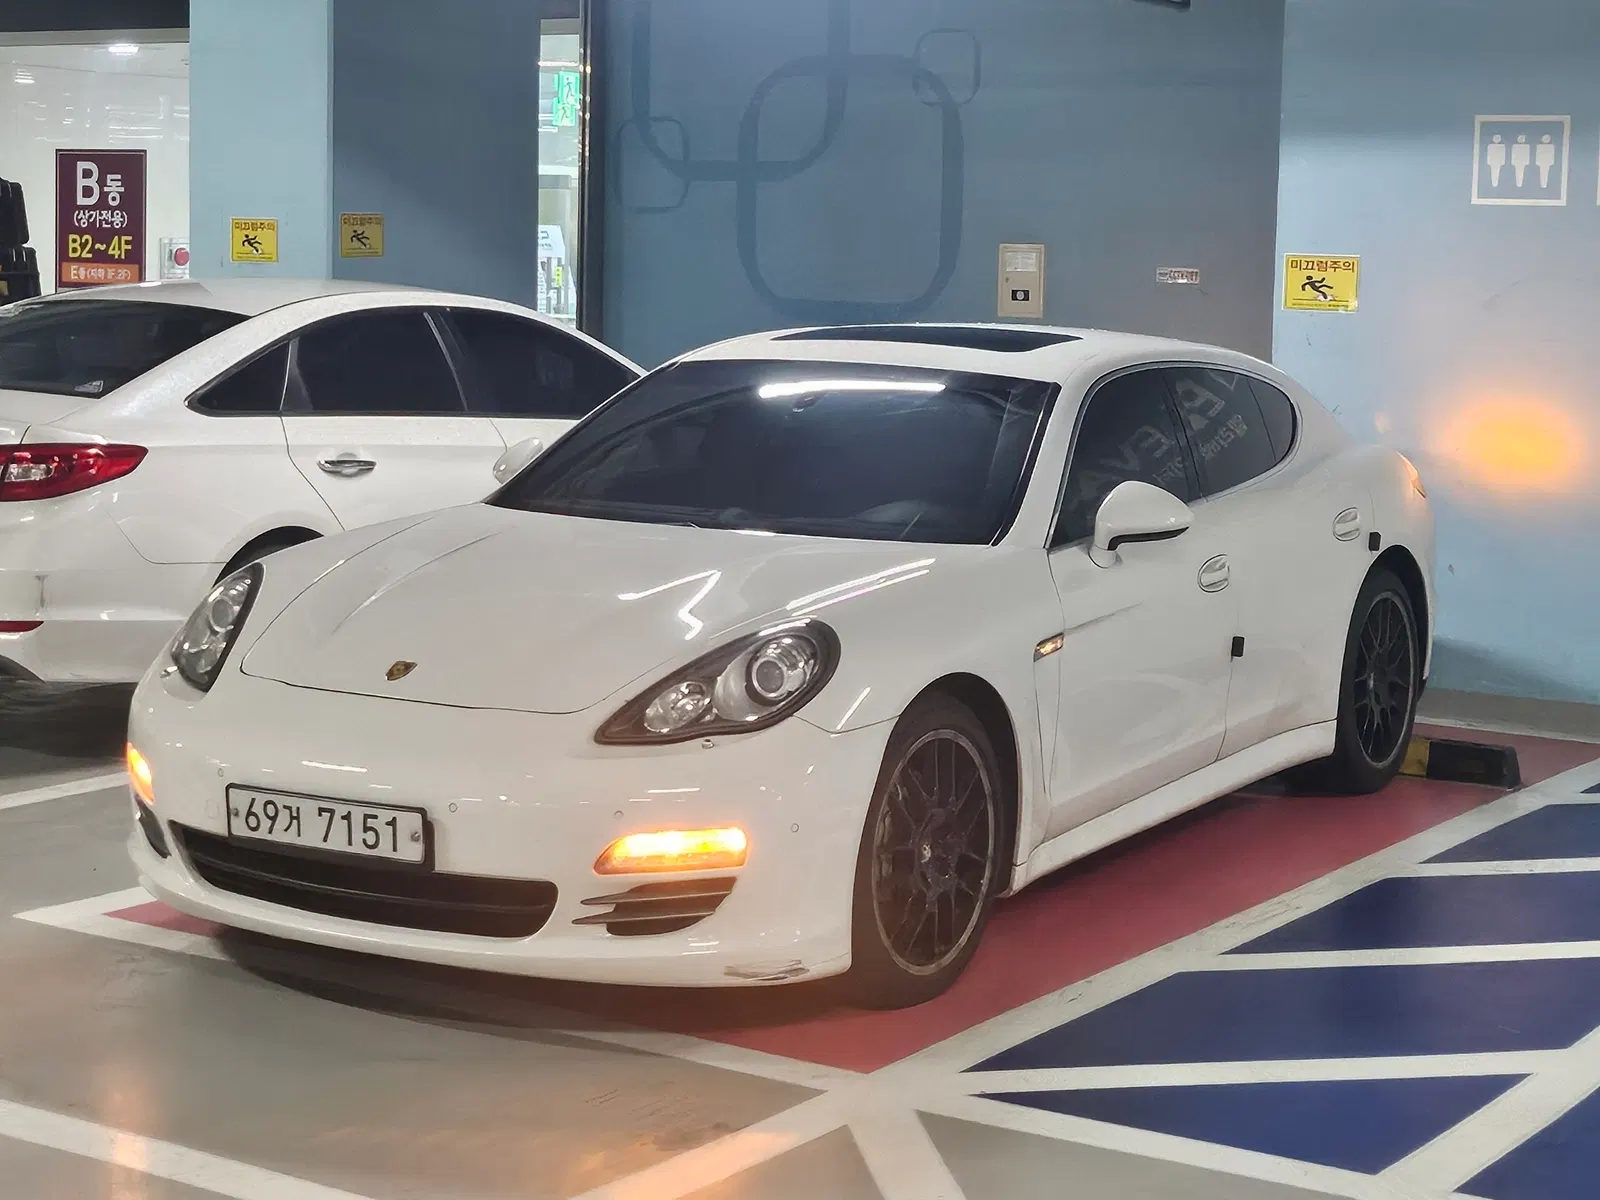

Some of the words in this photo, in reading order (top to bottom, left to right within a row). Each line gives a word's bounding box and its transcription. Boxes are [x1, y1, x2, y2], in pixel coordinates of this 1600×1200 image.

[73, 210, 128, 229] (상가전용)
[68, 233, 133, 260] B2~4F
[1290, 259, 1355, 273] 미끄럼주의
[244, 797, 302, 838] 69거
[317, 806, 398, 853] 7151
